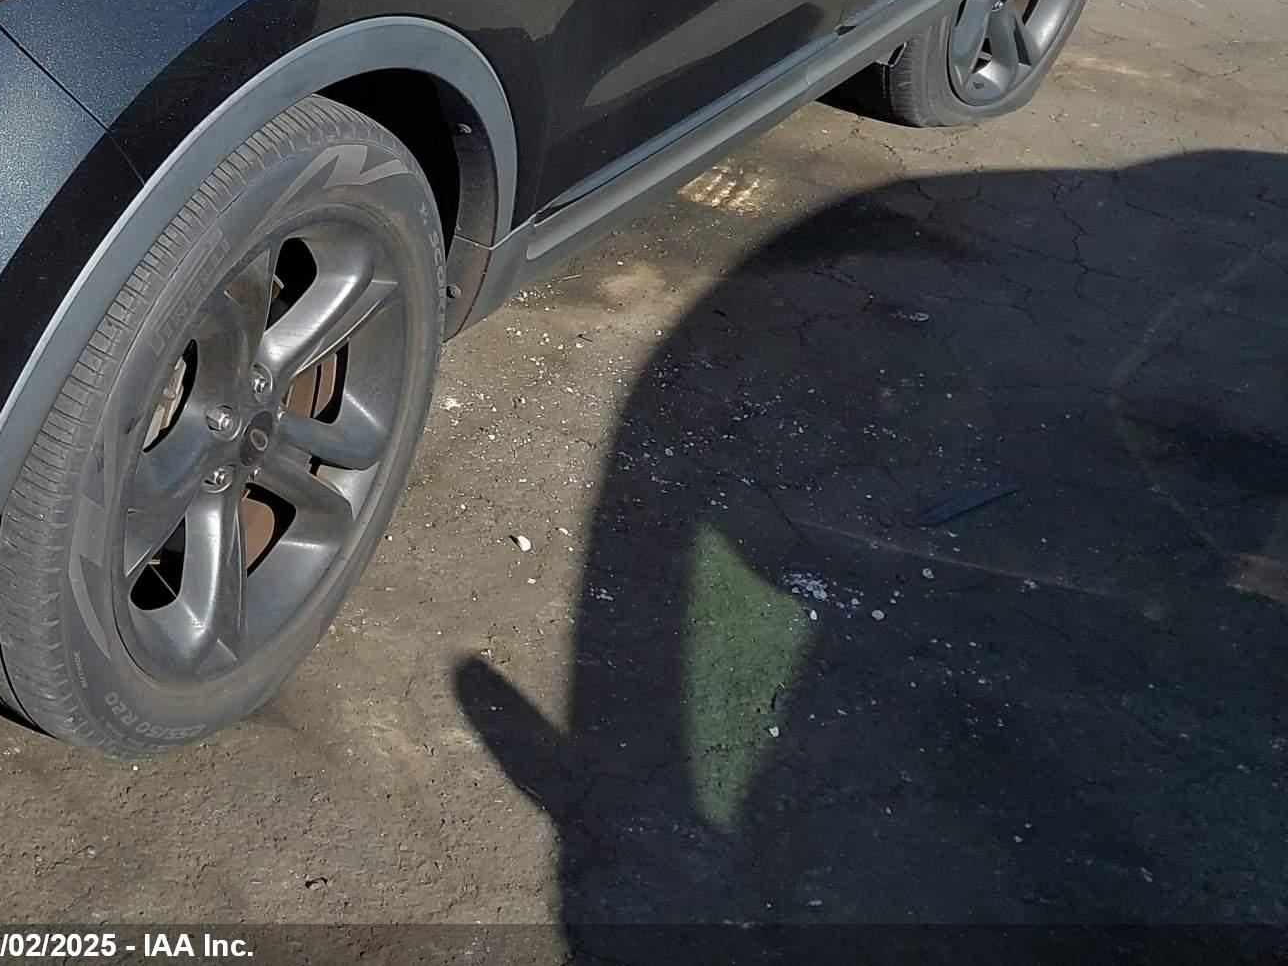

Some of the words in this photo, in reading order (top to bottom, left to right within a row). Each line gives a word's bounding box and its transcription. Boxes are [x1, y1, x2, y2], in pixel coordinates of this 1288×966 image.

[146, 227, 231, 356] PIRELLI
[105, 692, 139, 726] R20
[136, 721, 207, 740] 255/50
